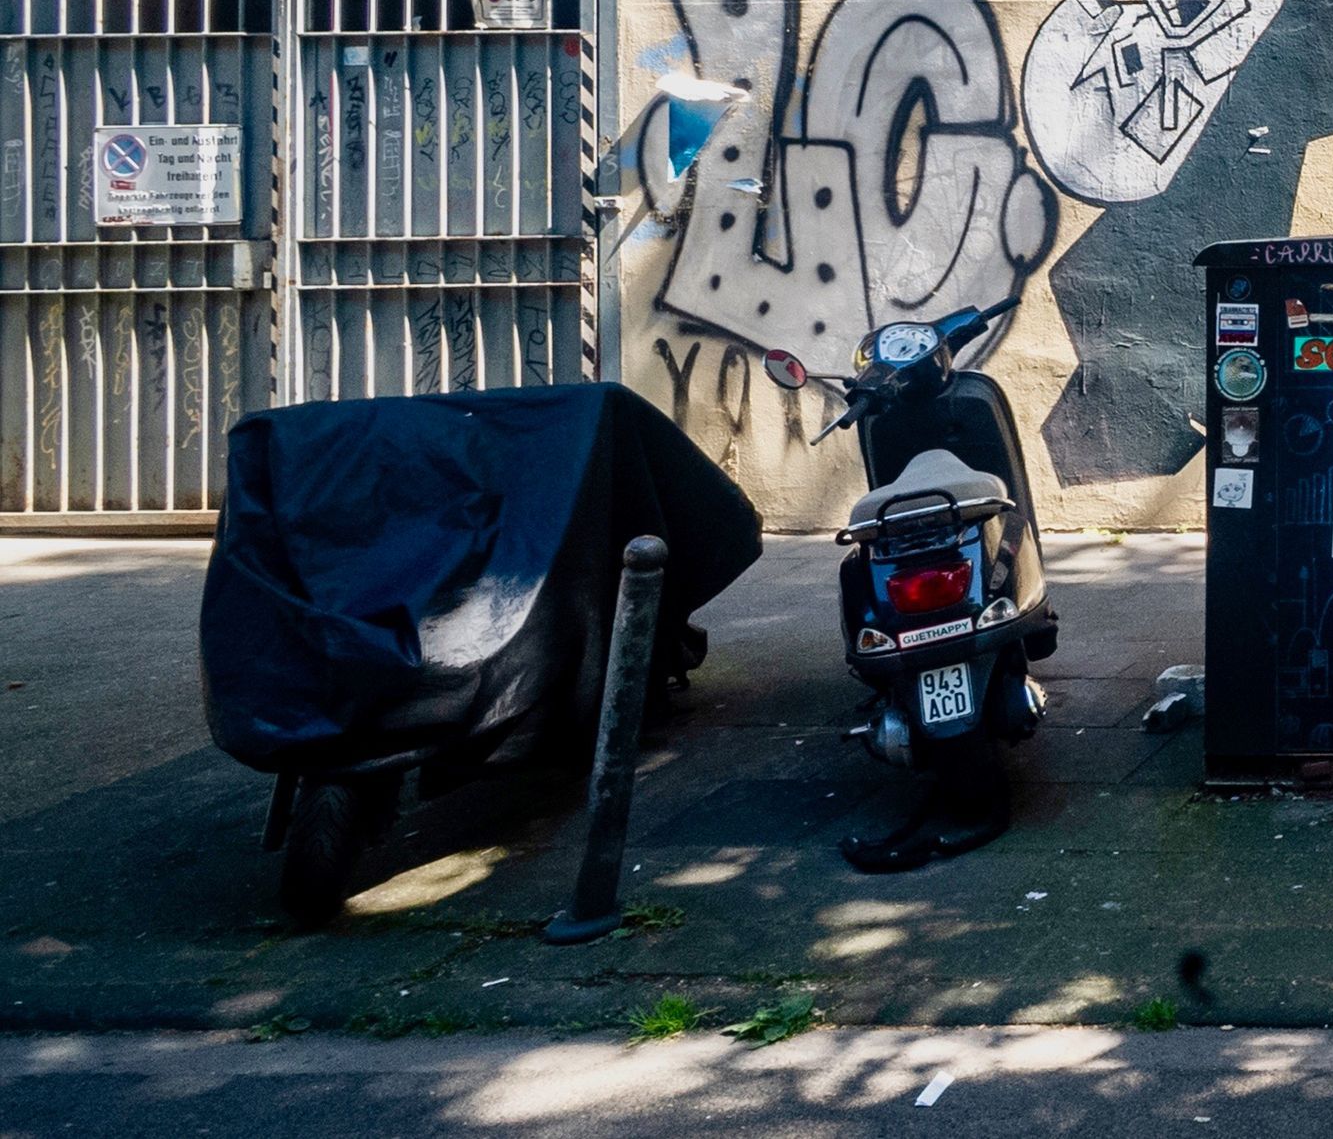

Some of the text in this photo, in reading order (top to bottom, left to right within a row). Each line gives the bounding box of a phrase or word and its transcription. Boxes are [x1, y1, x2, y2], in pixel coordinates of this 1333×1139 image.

[171, 136, 189, 146] und
[158, 153, 175, 166] Tag
[178, 154, 194, 163] und
[901, 620, 971, 647] GUETHAPPY
[922, 668, 965, 696] 943
[929, 693, 969, 723] ACD
